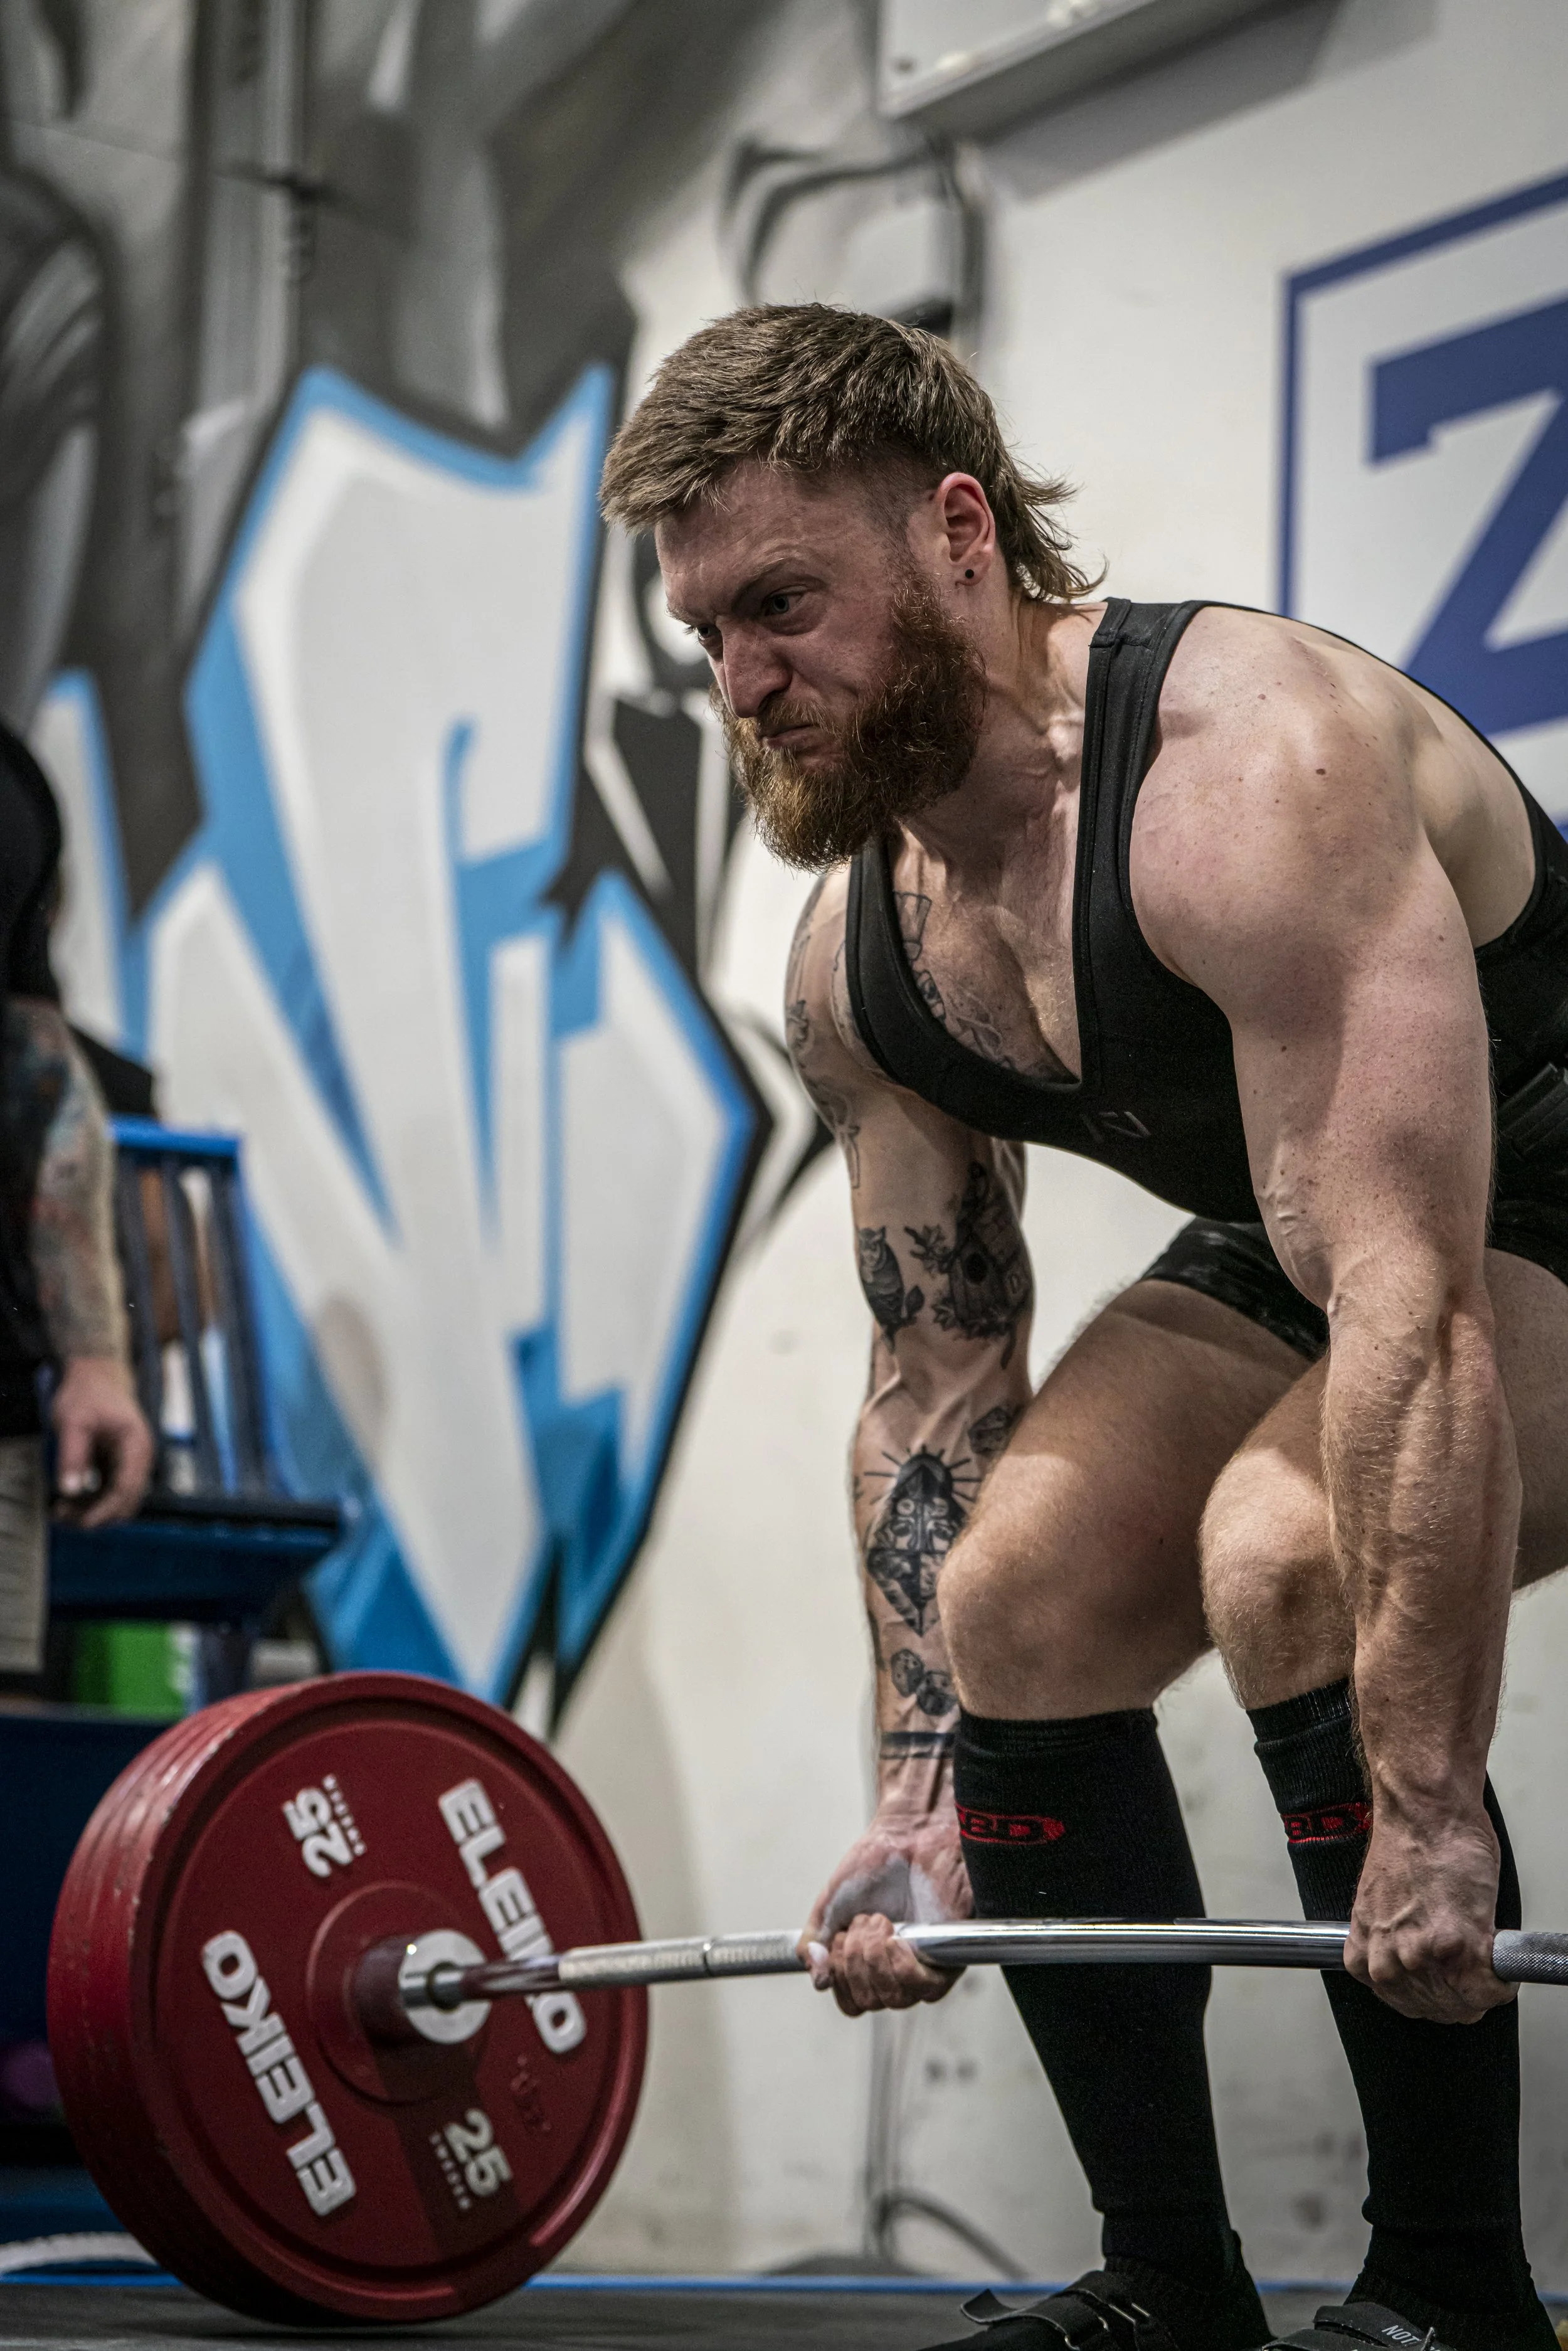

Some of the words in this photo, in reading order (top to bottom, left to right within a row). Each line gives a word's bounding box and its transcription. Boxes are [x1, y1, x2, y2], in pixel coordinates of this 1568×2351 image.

[282, 1788, 352, 1877] 25
[959, 1810, 1044, 1842] BD
[201, 1929, 356, 2216] ELEIKO
[444, 2108, 513, 2197] 25
